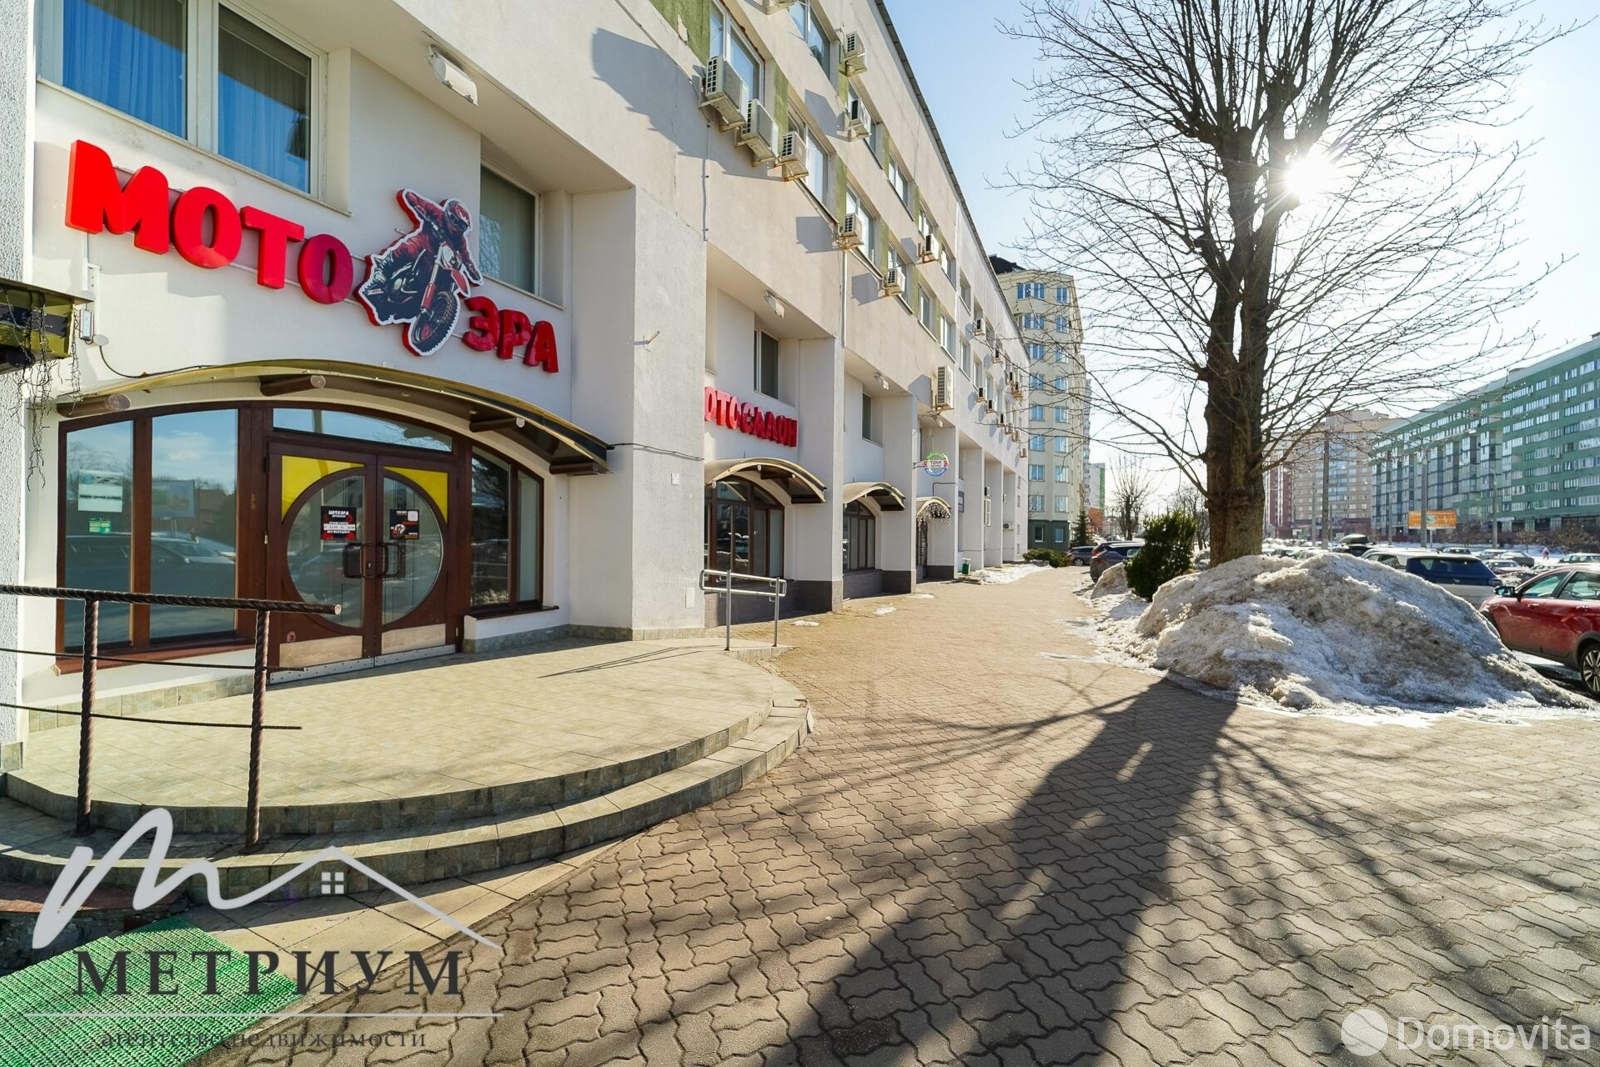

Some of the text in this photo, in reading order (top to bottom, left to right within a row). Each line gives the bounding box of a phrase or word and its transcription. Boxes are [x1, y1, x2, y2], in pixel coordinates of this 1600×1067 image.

[66, 140, 559, 373] МОТО ЭРА
[704, 386, 798, 448] ОТОСАЛОН
